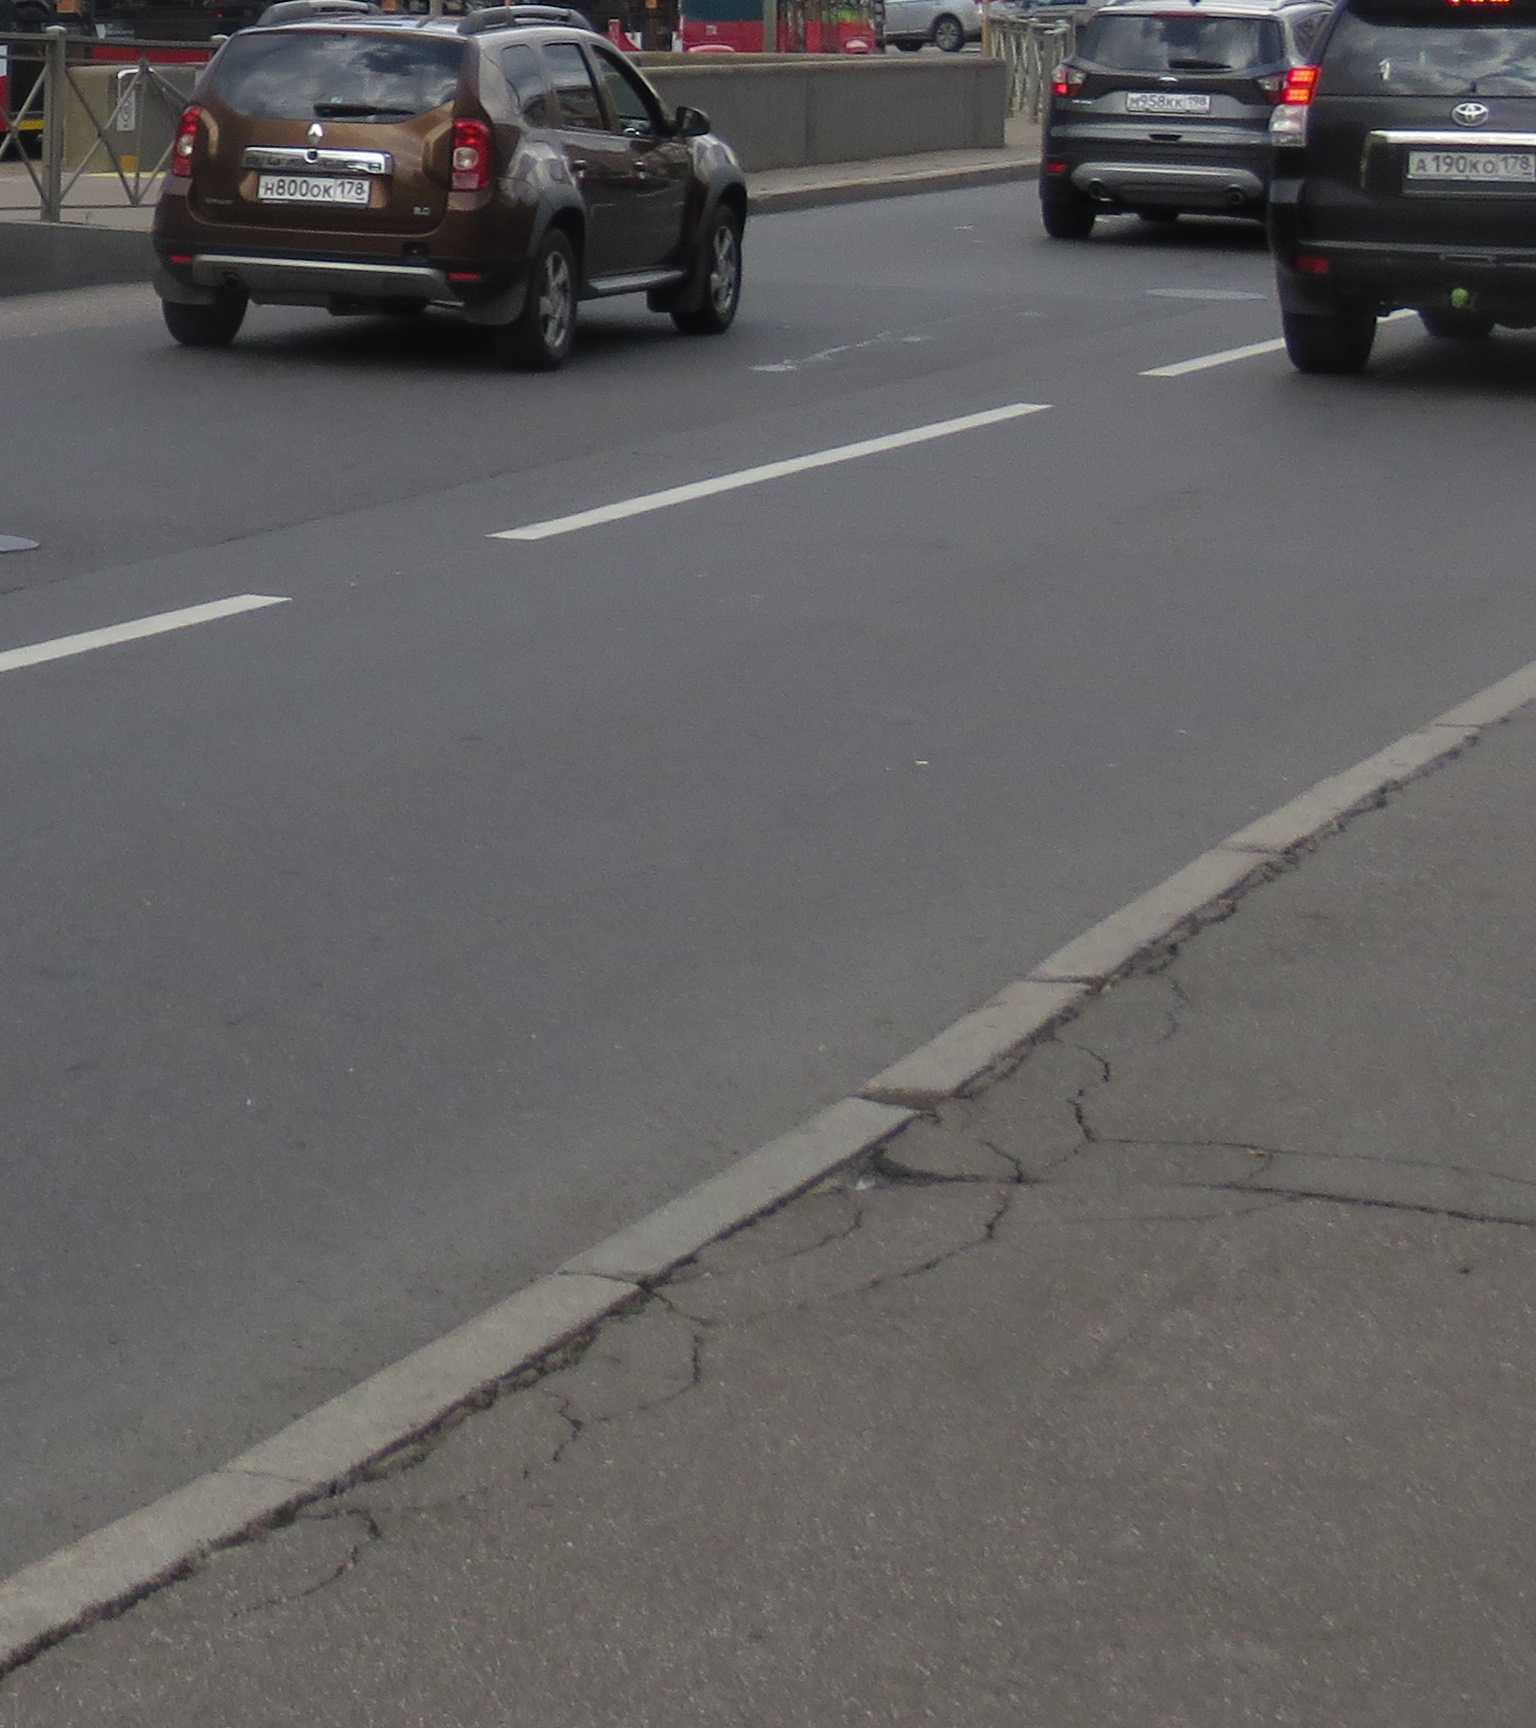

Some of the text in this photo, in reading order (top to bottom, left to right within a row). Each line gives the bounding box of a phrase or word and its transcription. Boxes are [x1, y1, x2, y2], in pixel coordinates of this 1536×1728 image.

[1129, 94, 1206, 109] М958КК 198
[1415, 155, 1532, 173] А190КО 178
[264, 178, 365, 198] Н800ОК 178
